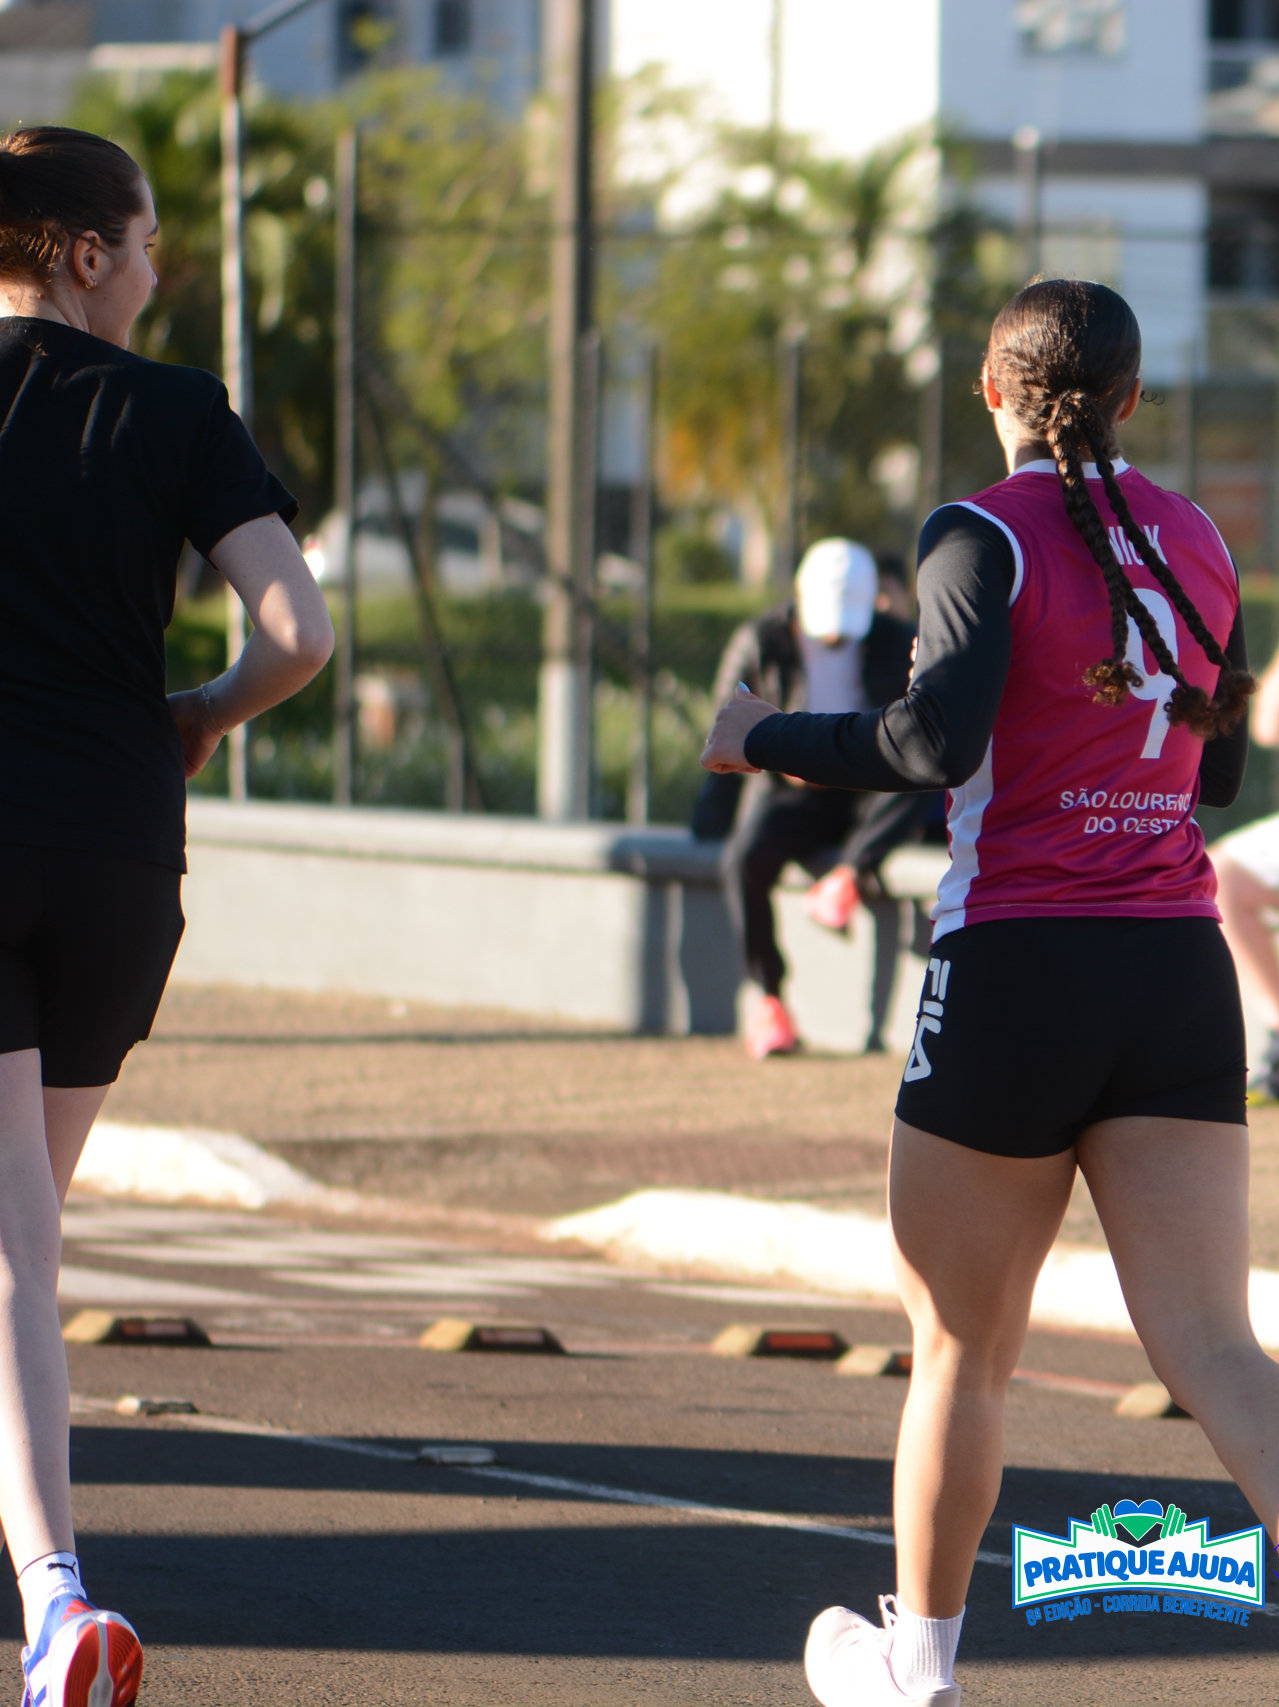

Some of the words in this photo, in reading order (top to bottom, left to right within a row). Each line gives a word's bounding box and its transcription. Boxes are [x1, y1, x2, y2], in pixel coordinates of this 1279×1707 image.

[1126, 588, 1179, 760] 9
[1060, 788, 1108, 809] SÃO
[1084, 816, 1117, 834] DO
[904, 957, 952, 1083] FILA
